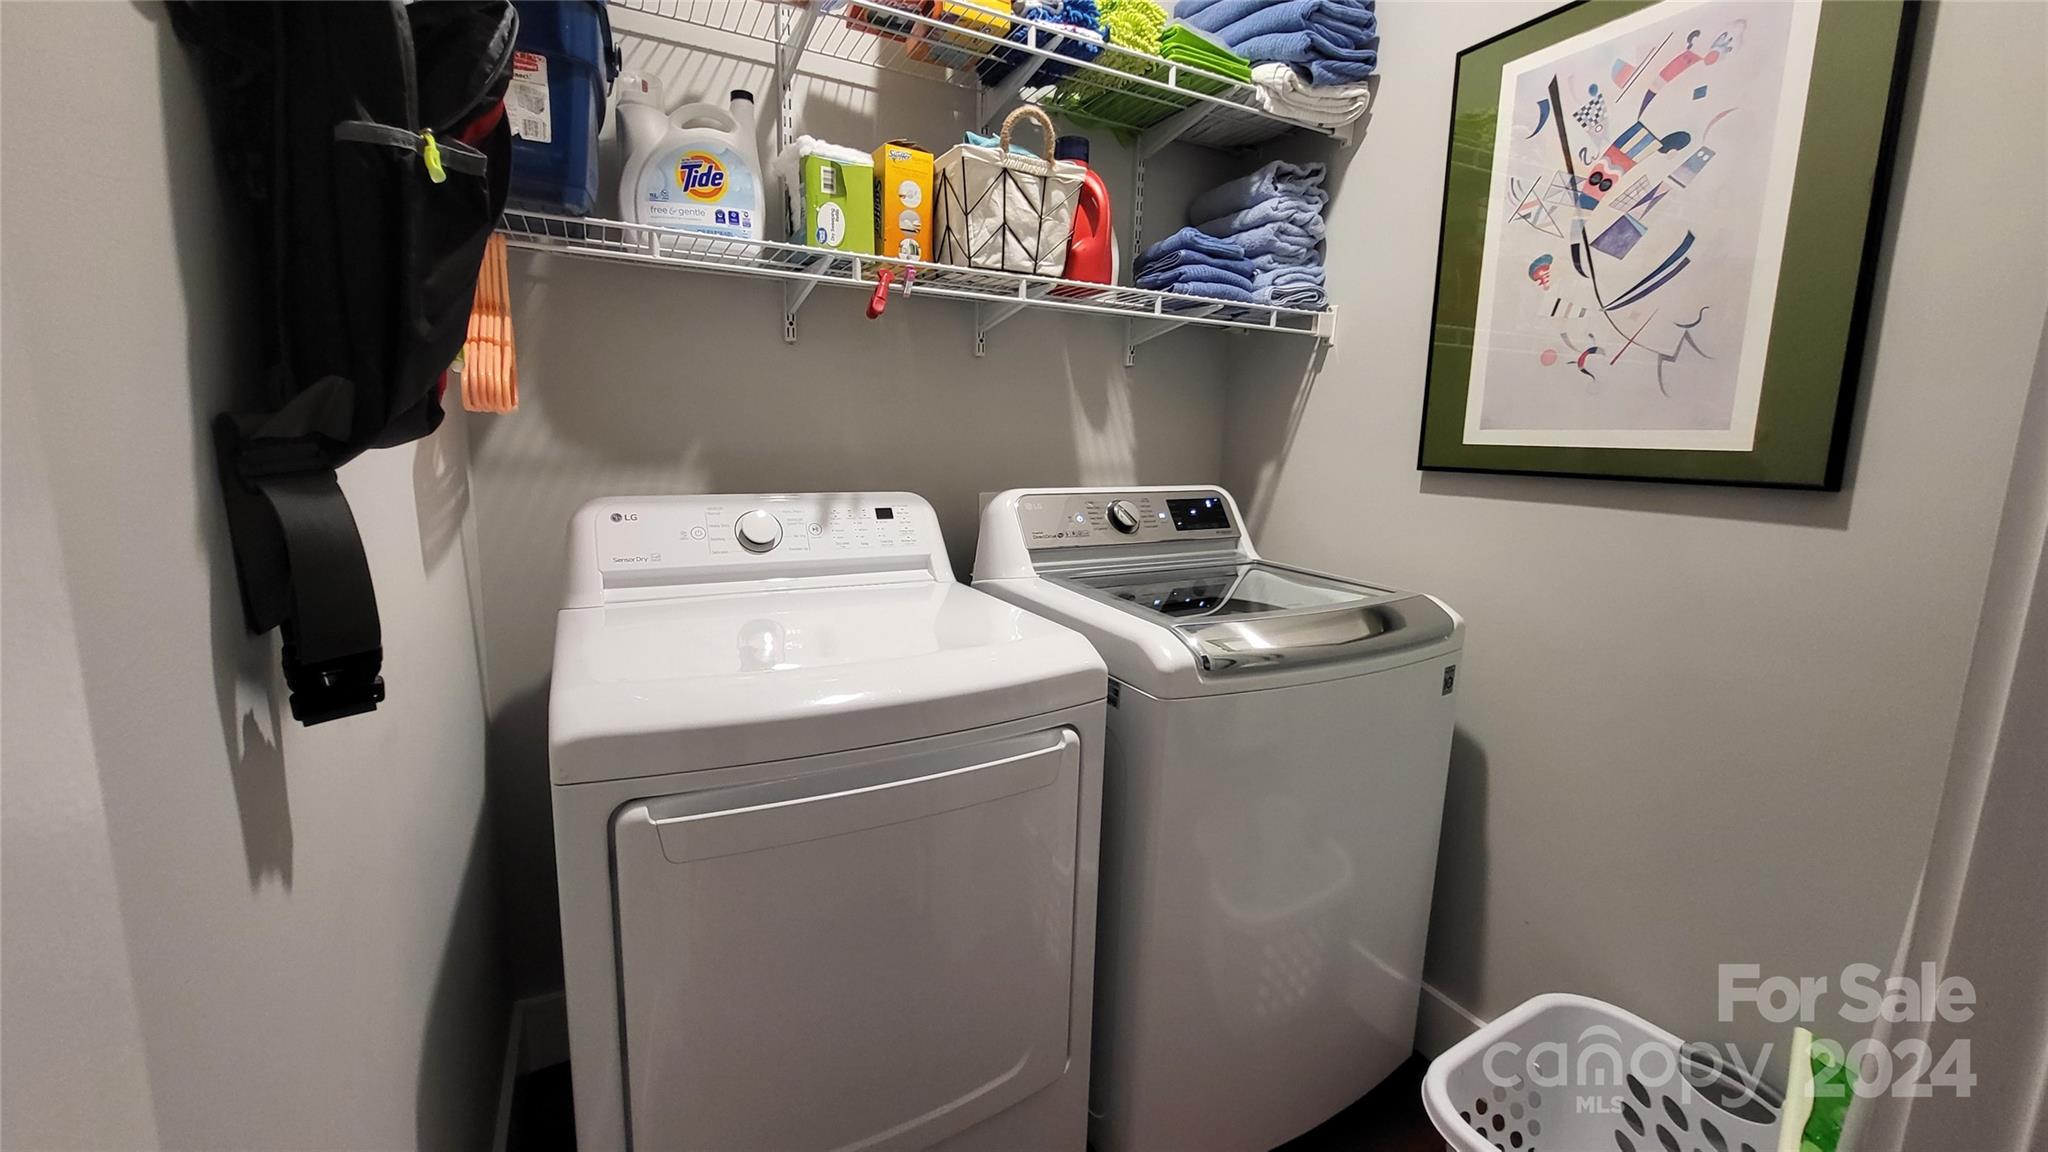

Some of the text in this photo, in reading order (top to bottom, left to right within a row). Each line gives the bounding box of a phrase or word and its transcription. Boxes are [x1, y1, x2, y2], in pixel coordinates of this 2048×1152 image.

[680, 163, 724, 192] Tide
[650, 206, 706, 218] free & gentle
[624, 513, 638, 521] LG
